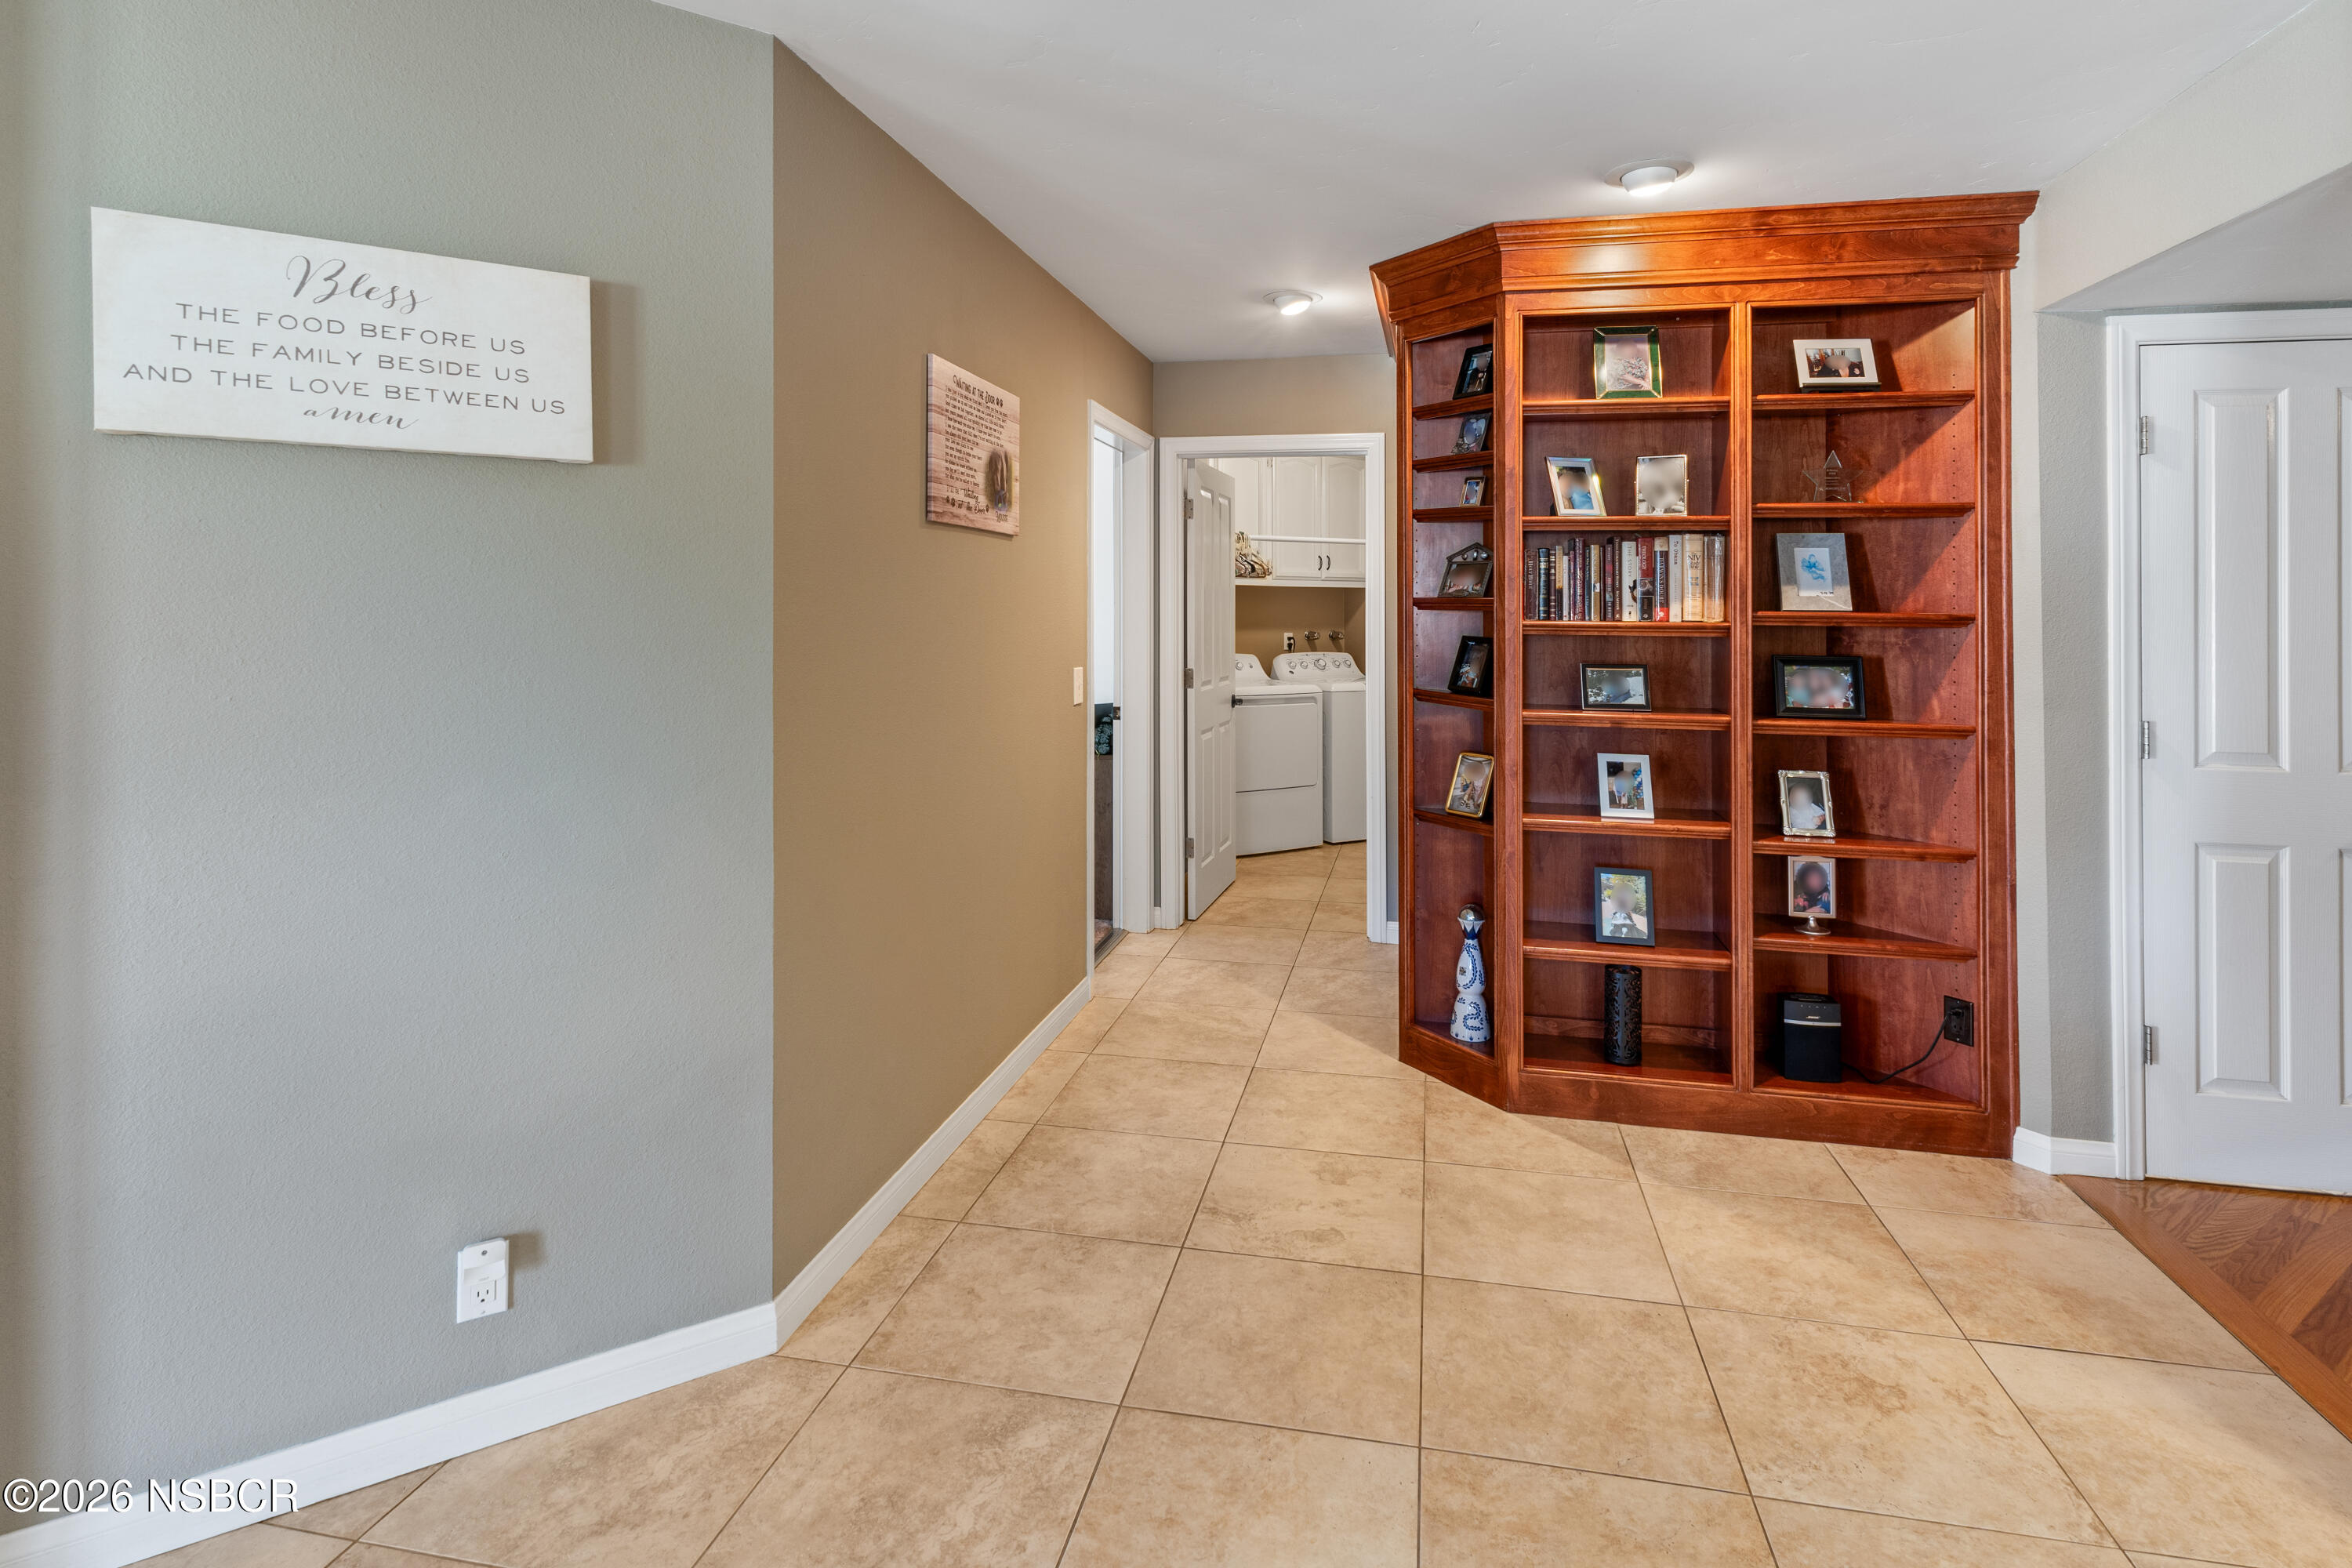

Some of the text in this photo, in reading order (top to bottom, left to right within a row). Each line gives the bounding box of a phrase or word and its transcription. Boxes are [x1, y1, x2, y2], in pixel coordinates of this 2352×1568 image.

[286, 255, 433, 315] Bless
[175, 303, 526, 355] THE FOOD BEFORE US
[170, 334, 530, 383] THE FAMILY BESIDE US
[122, 363, 566, 415] AND THE LOVE BETWEEN US
[303, 408, 419, 430] amen
